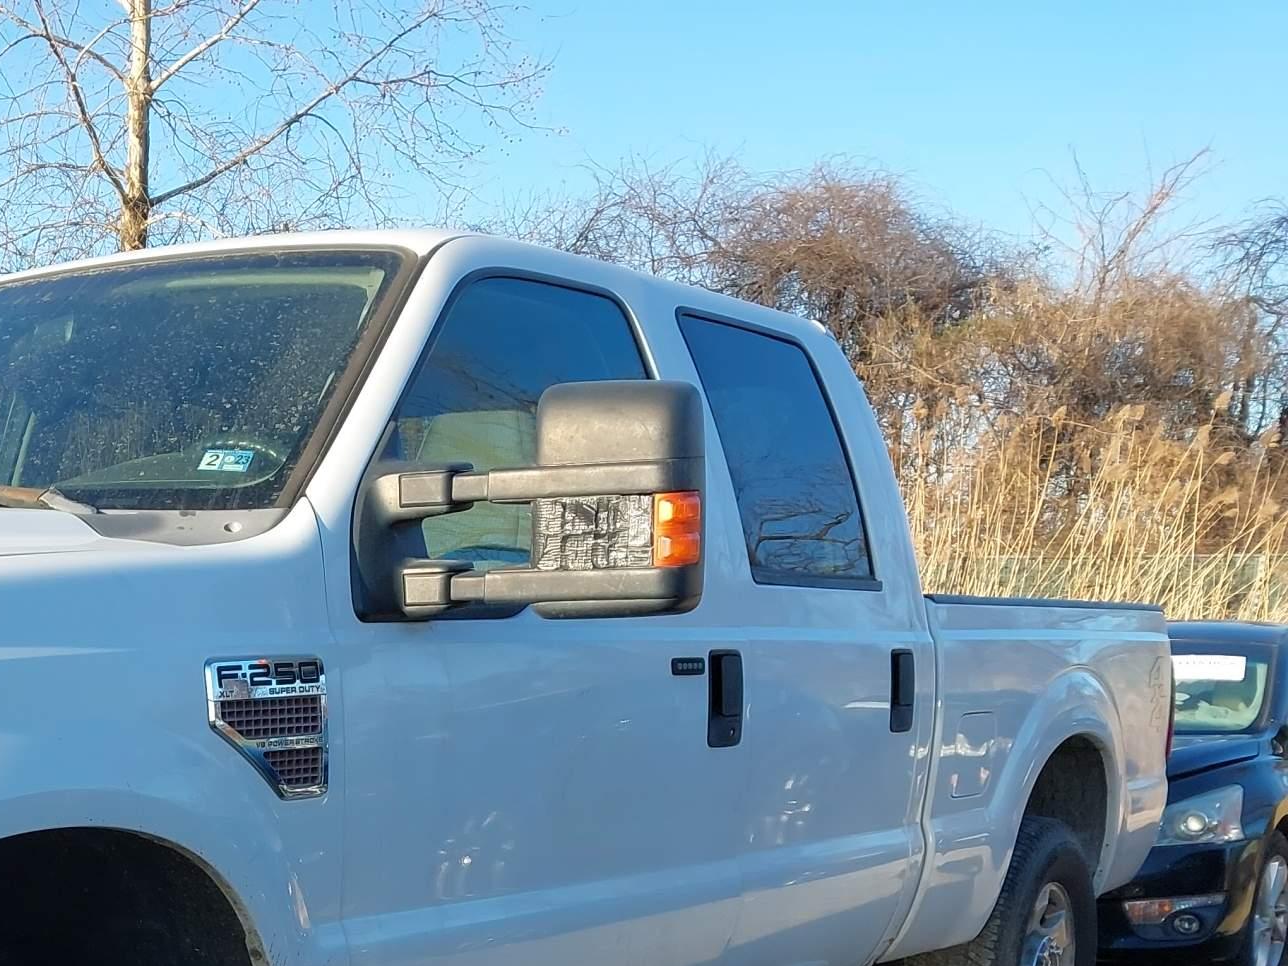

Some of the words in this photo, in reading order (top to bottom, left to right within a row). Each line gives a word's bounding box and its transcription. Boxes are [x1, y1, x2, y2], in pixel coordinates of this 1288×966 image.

[205, 454, 220, 466] 2
[235, 454, 251, 465] 23
[216, 661, 320, 689] F-250
[218, 690, 235, 699] XLT
[268, 686, 297, 695] SUPER
[298, 685, 321, 693] DUTY
